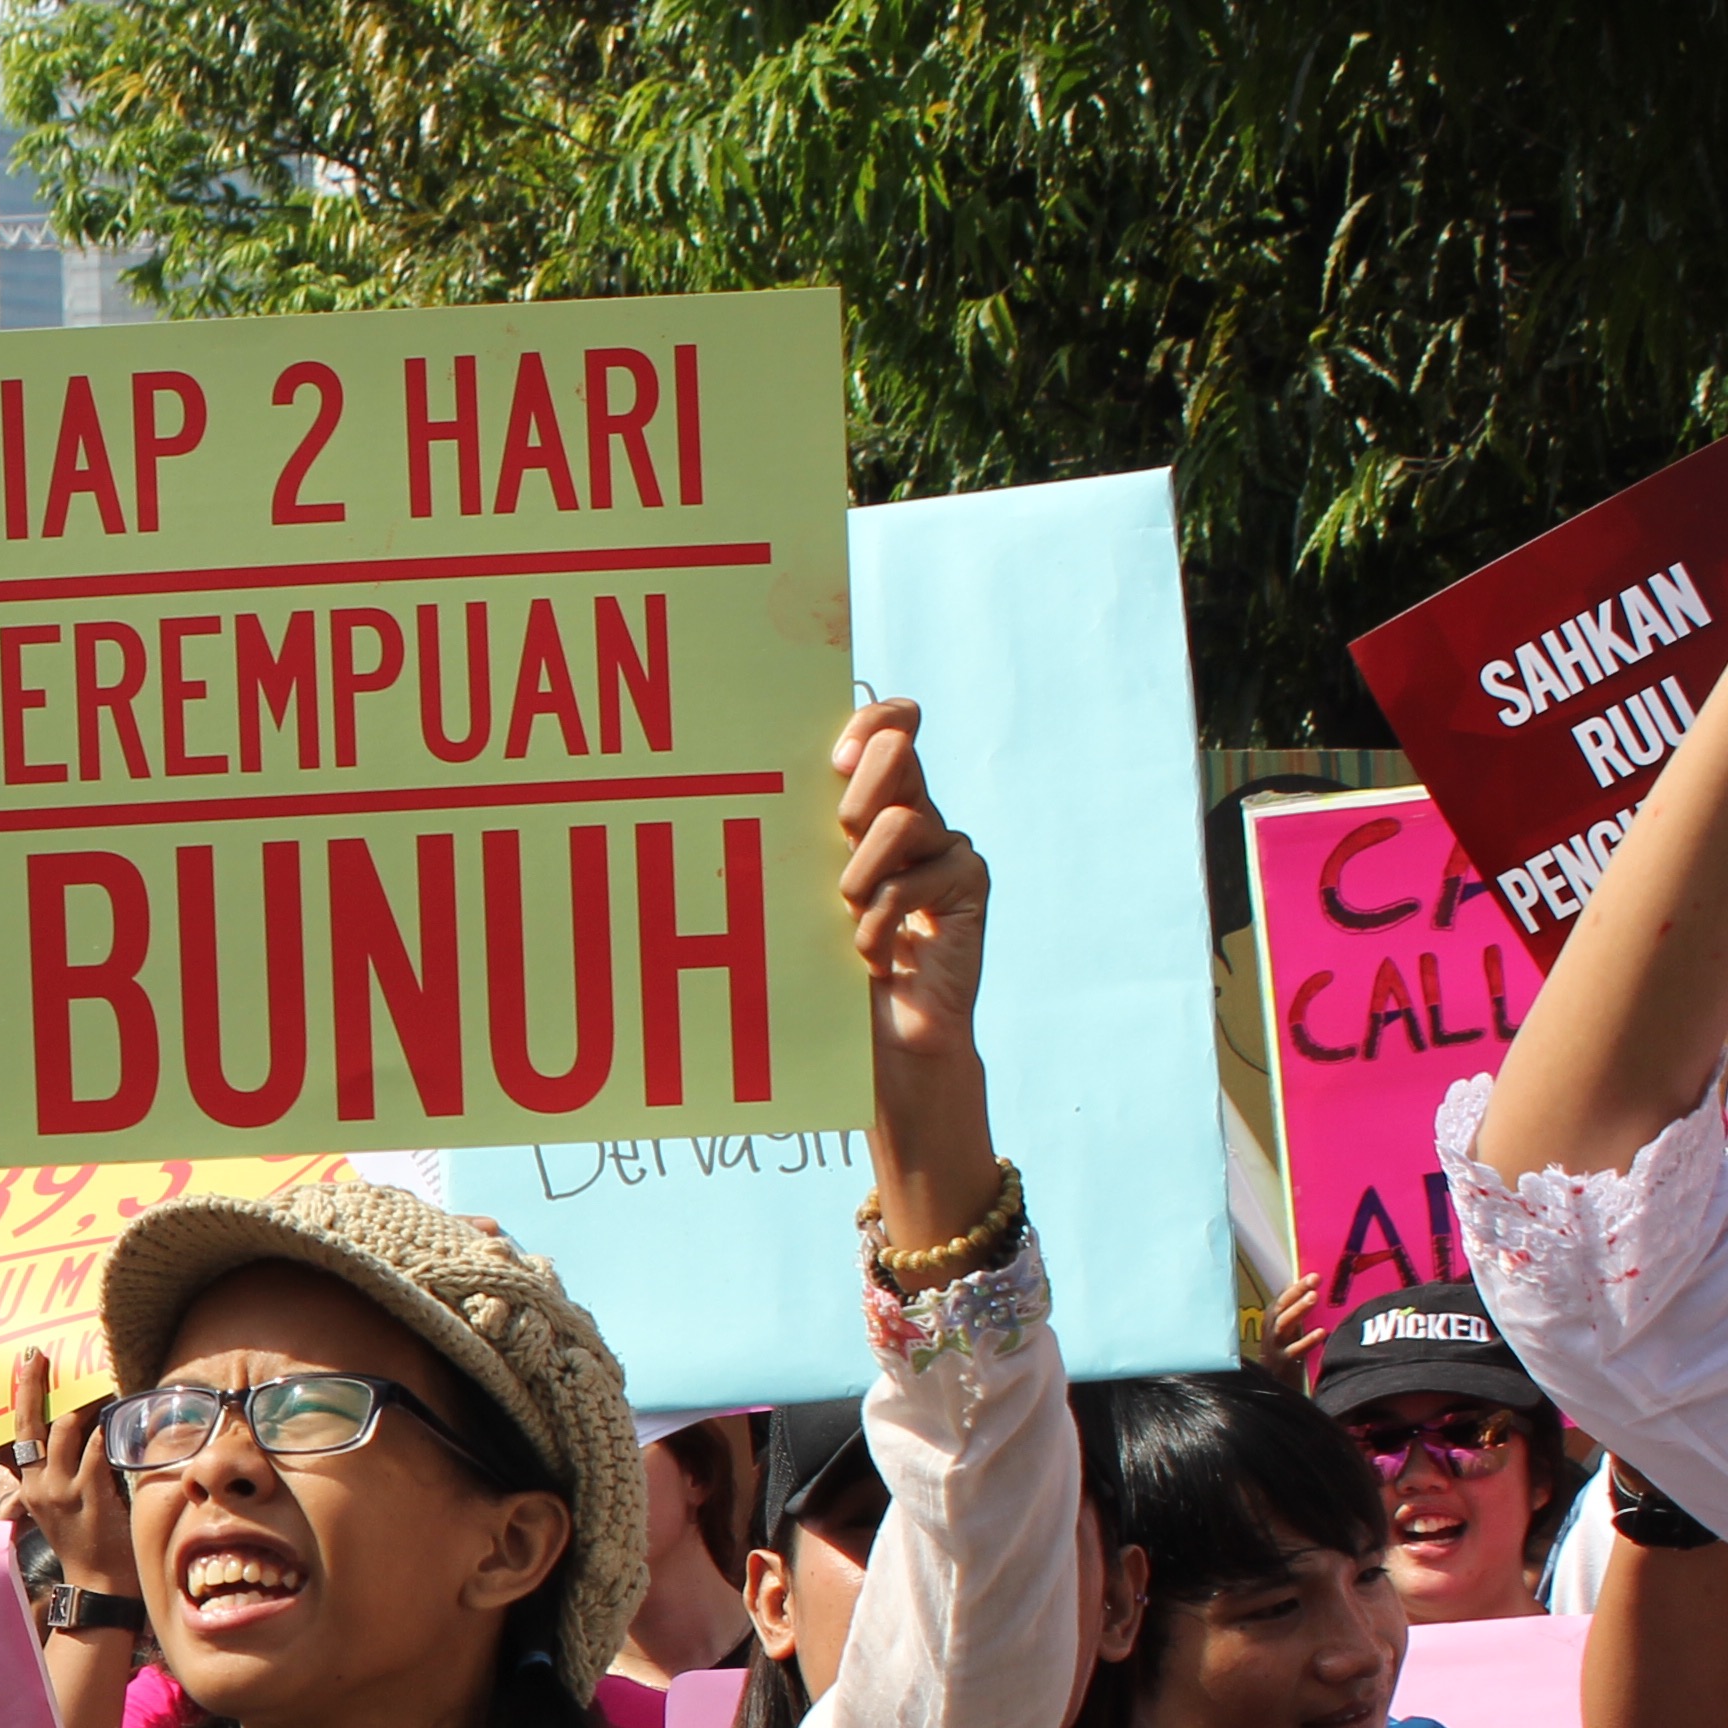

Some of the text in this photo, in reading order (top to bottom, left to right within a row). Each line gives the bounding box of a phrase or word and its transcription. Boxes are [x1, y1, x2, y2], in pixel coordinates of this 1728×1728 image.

[270, 361, 346, 525] 2
[404, 344, 705, 519] HARI
[1480, 562, 1712, 727] SAHKAN
[1571, 676, 1698, 789] RUU
[26, 817, 772, 1135] BUNUH
